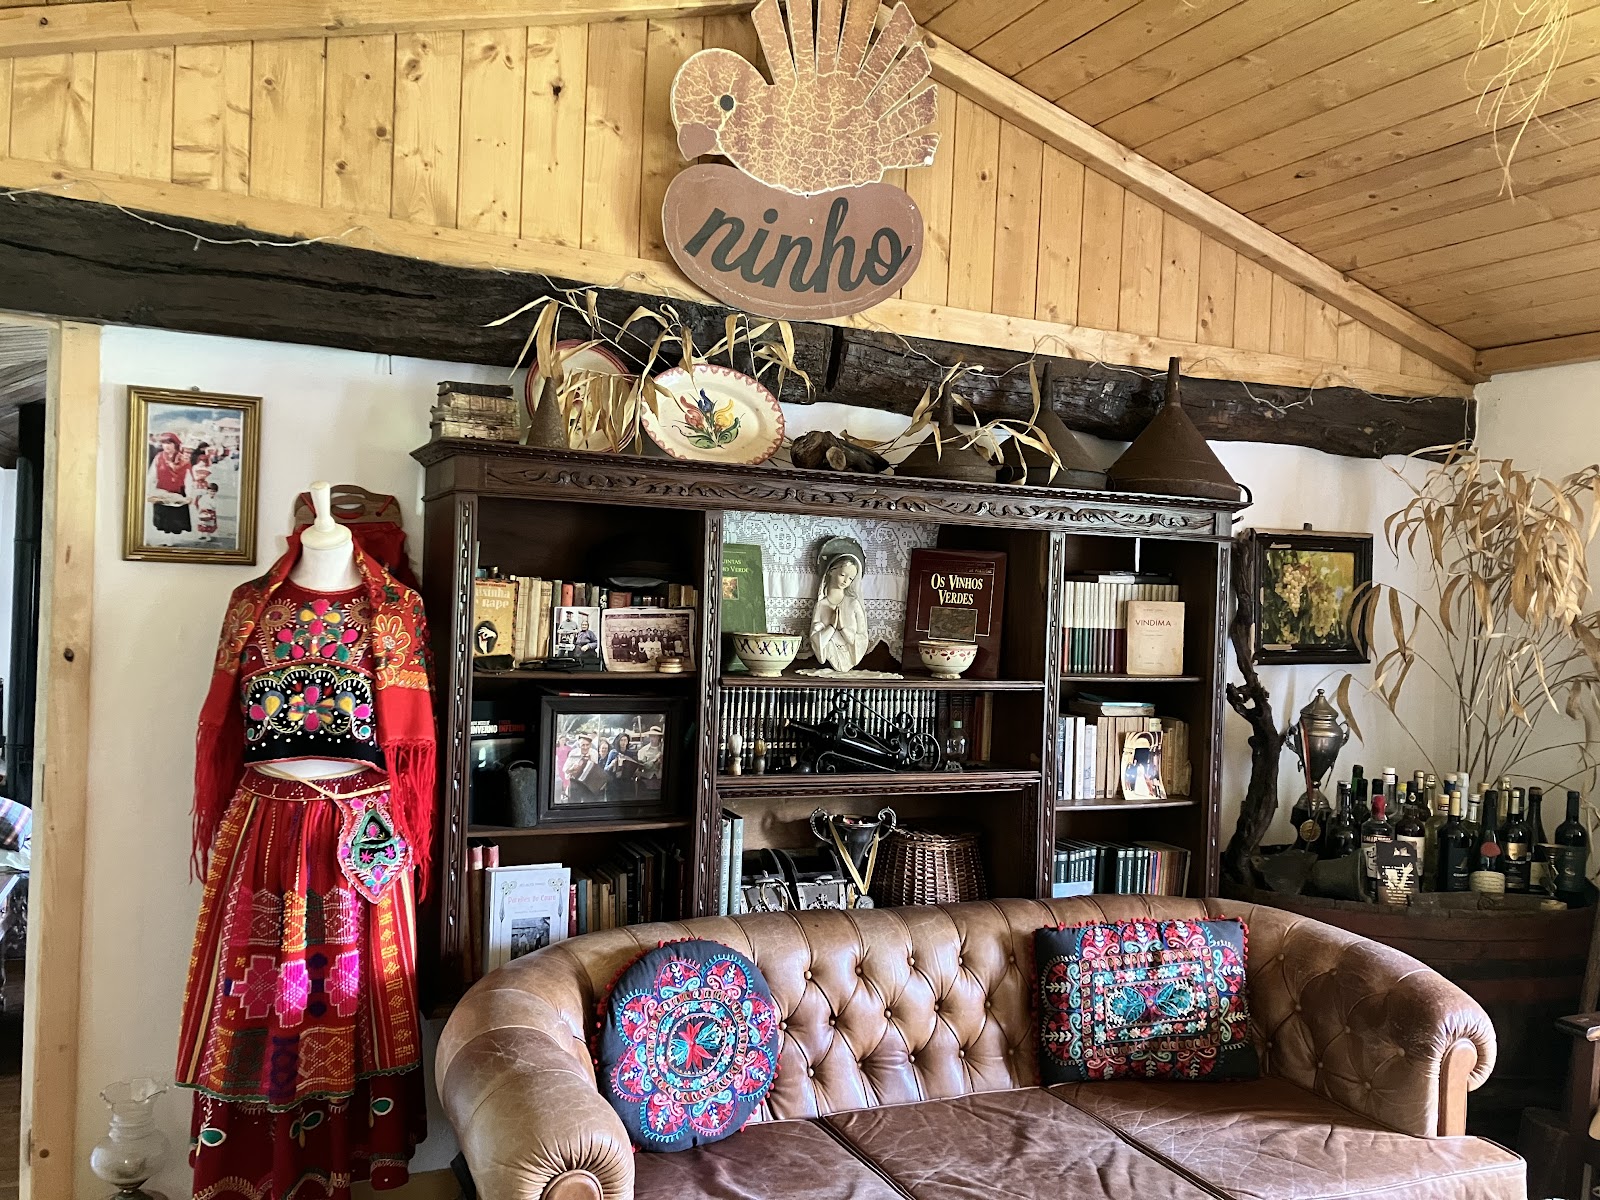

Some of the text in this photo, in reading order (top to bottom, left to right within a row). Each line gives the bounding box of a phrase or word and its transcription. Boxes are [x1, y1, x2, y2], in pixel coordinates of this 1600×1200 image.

[682, 197, 913, 293] ninho
[949, 574, 983, 590] VINHOS
[938, 589, 974, 606] VERDES
[1135, 619, 1172, 627] VINDIMA
